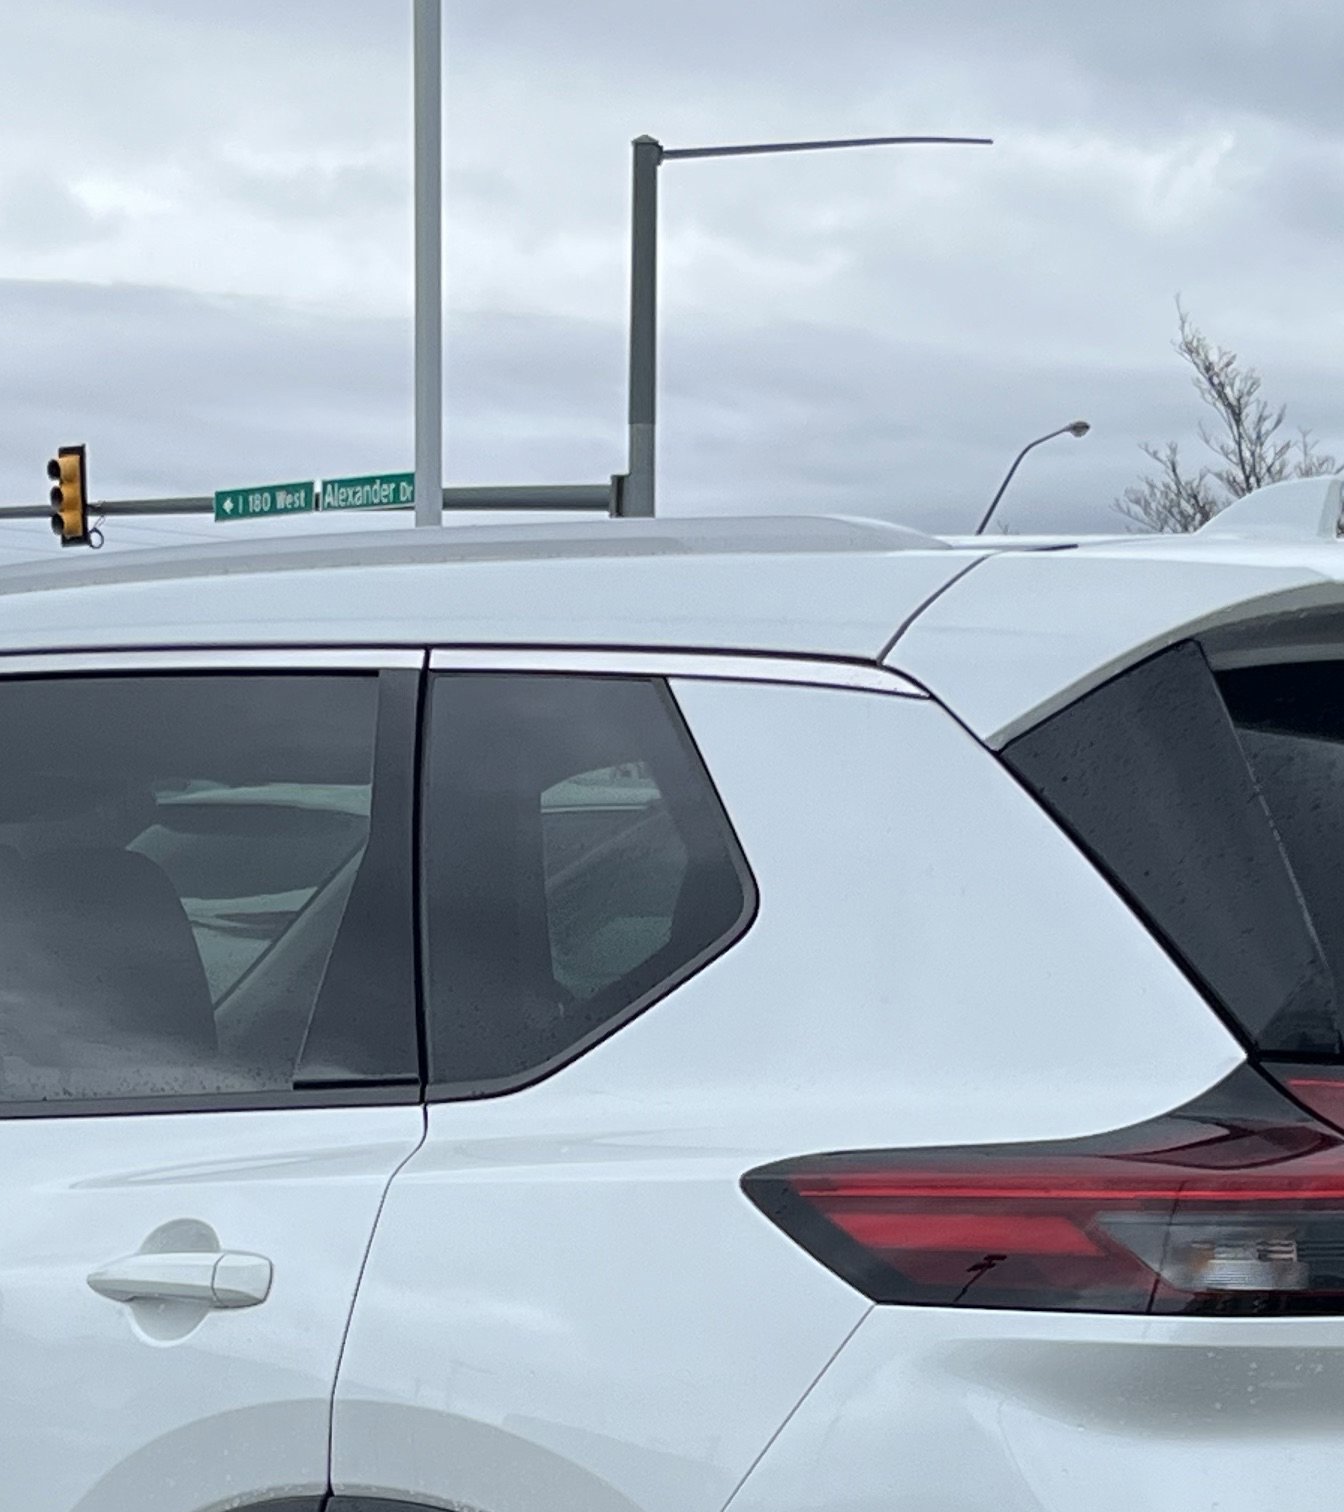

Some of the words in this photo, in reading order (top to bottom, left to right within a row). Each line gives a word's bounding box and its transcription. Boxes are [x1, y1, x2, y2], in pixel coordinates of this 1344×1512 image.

[249, 493, 271, 512] 180
[275, 489, 305, 510] West
[324, 479, 395, 508] Alexander
[400, 482, 413, 501] Dr
